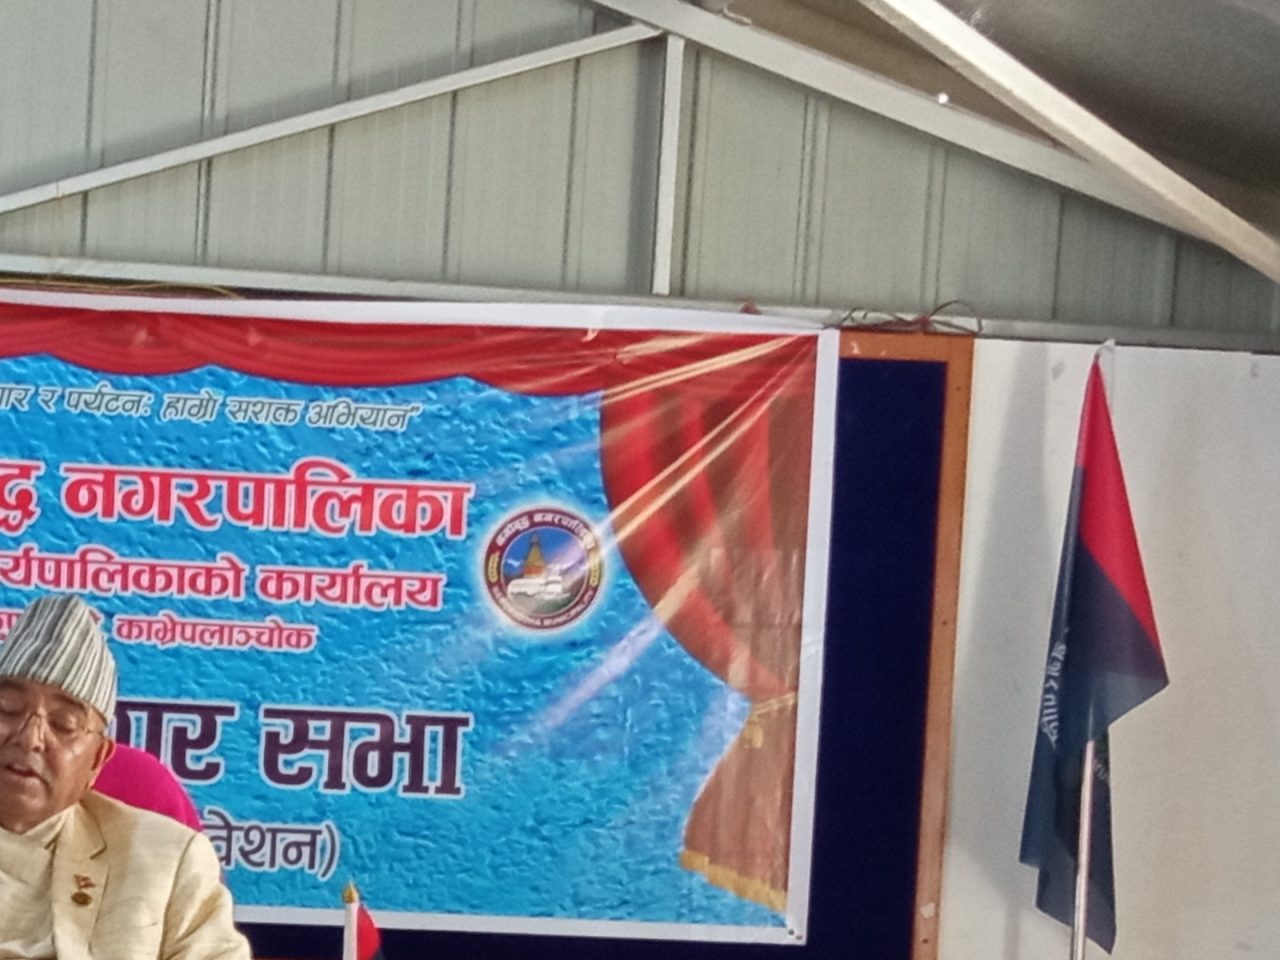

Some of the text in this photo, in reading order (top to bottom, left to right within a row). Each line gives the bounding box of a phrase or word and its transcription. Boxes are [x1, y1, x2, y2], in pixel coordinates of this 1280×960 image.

[41, 388, 59, 409] र
[64, 460, 472, 536] नगरपालिका
[259, 565, 443, 608] कार्यालय
[263, 708, 469, 796] सभा
